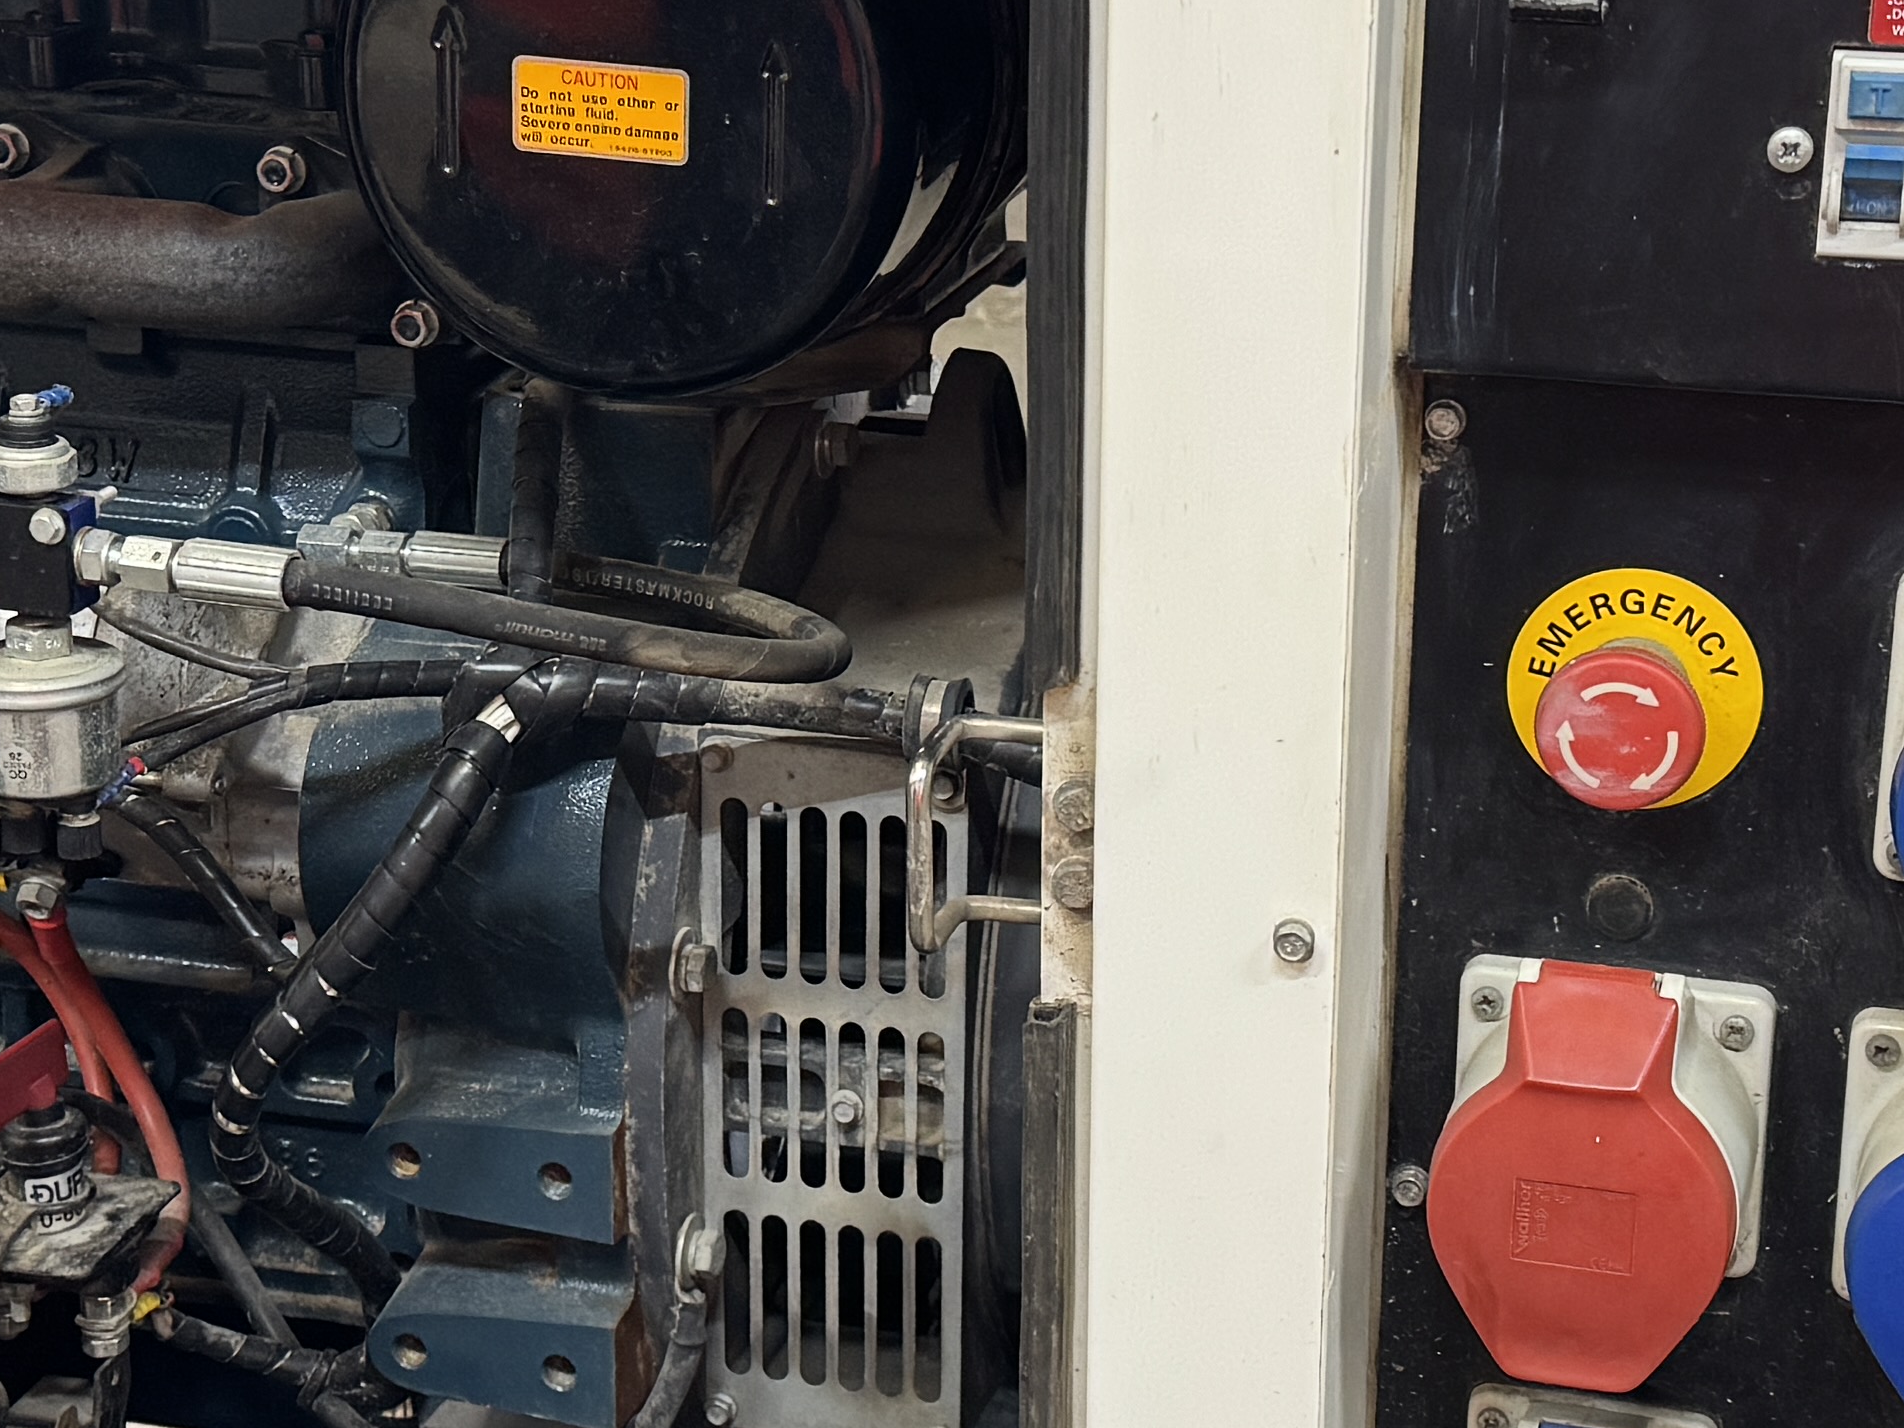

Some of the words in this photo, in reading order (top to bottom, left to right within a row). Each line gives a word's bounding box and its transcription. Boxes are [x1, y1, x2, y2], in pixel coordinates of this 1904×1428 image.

[561, 70, 639, 91] CAUTION
[521, 86, 538, 99] Do
[1528, 588, 1739, 678] EMERGENCY
